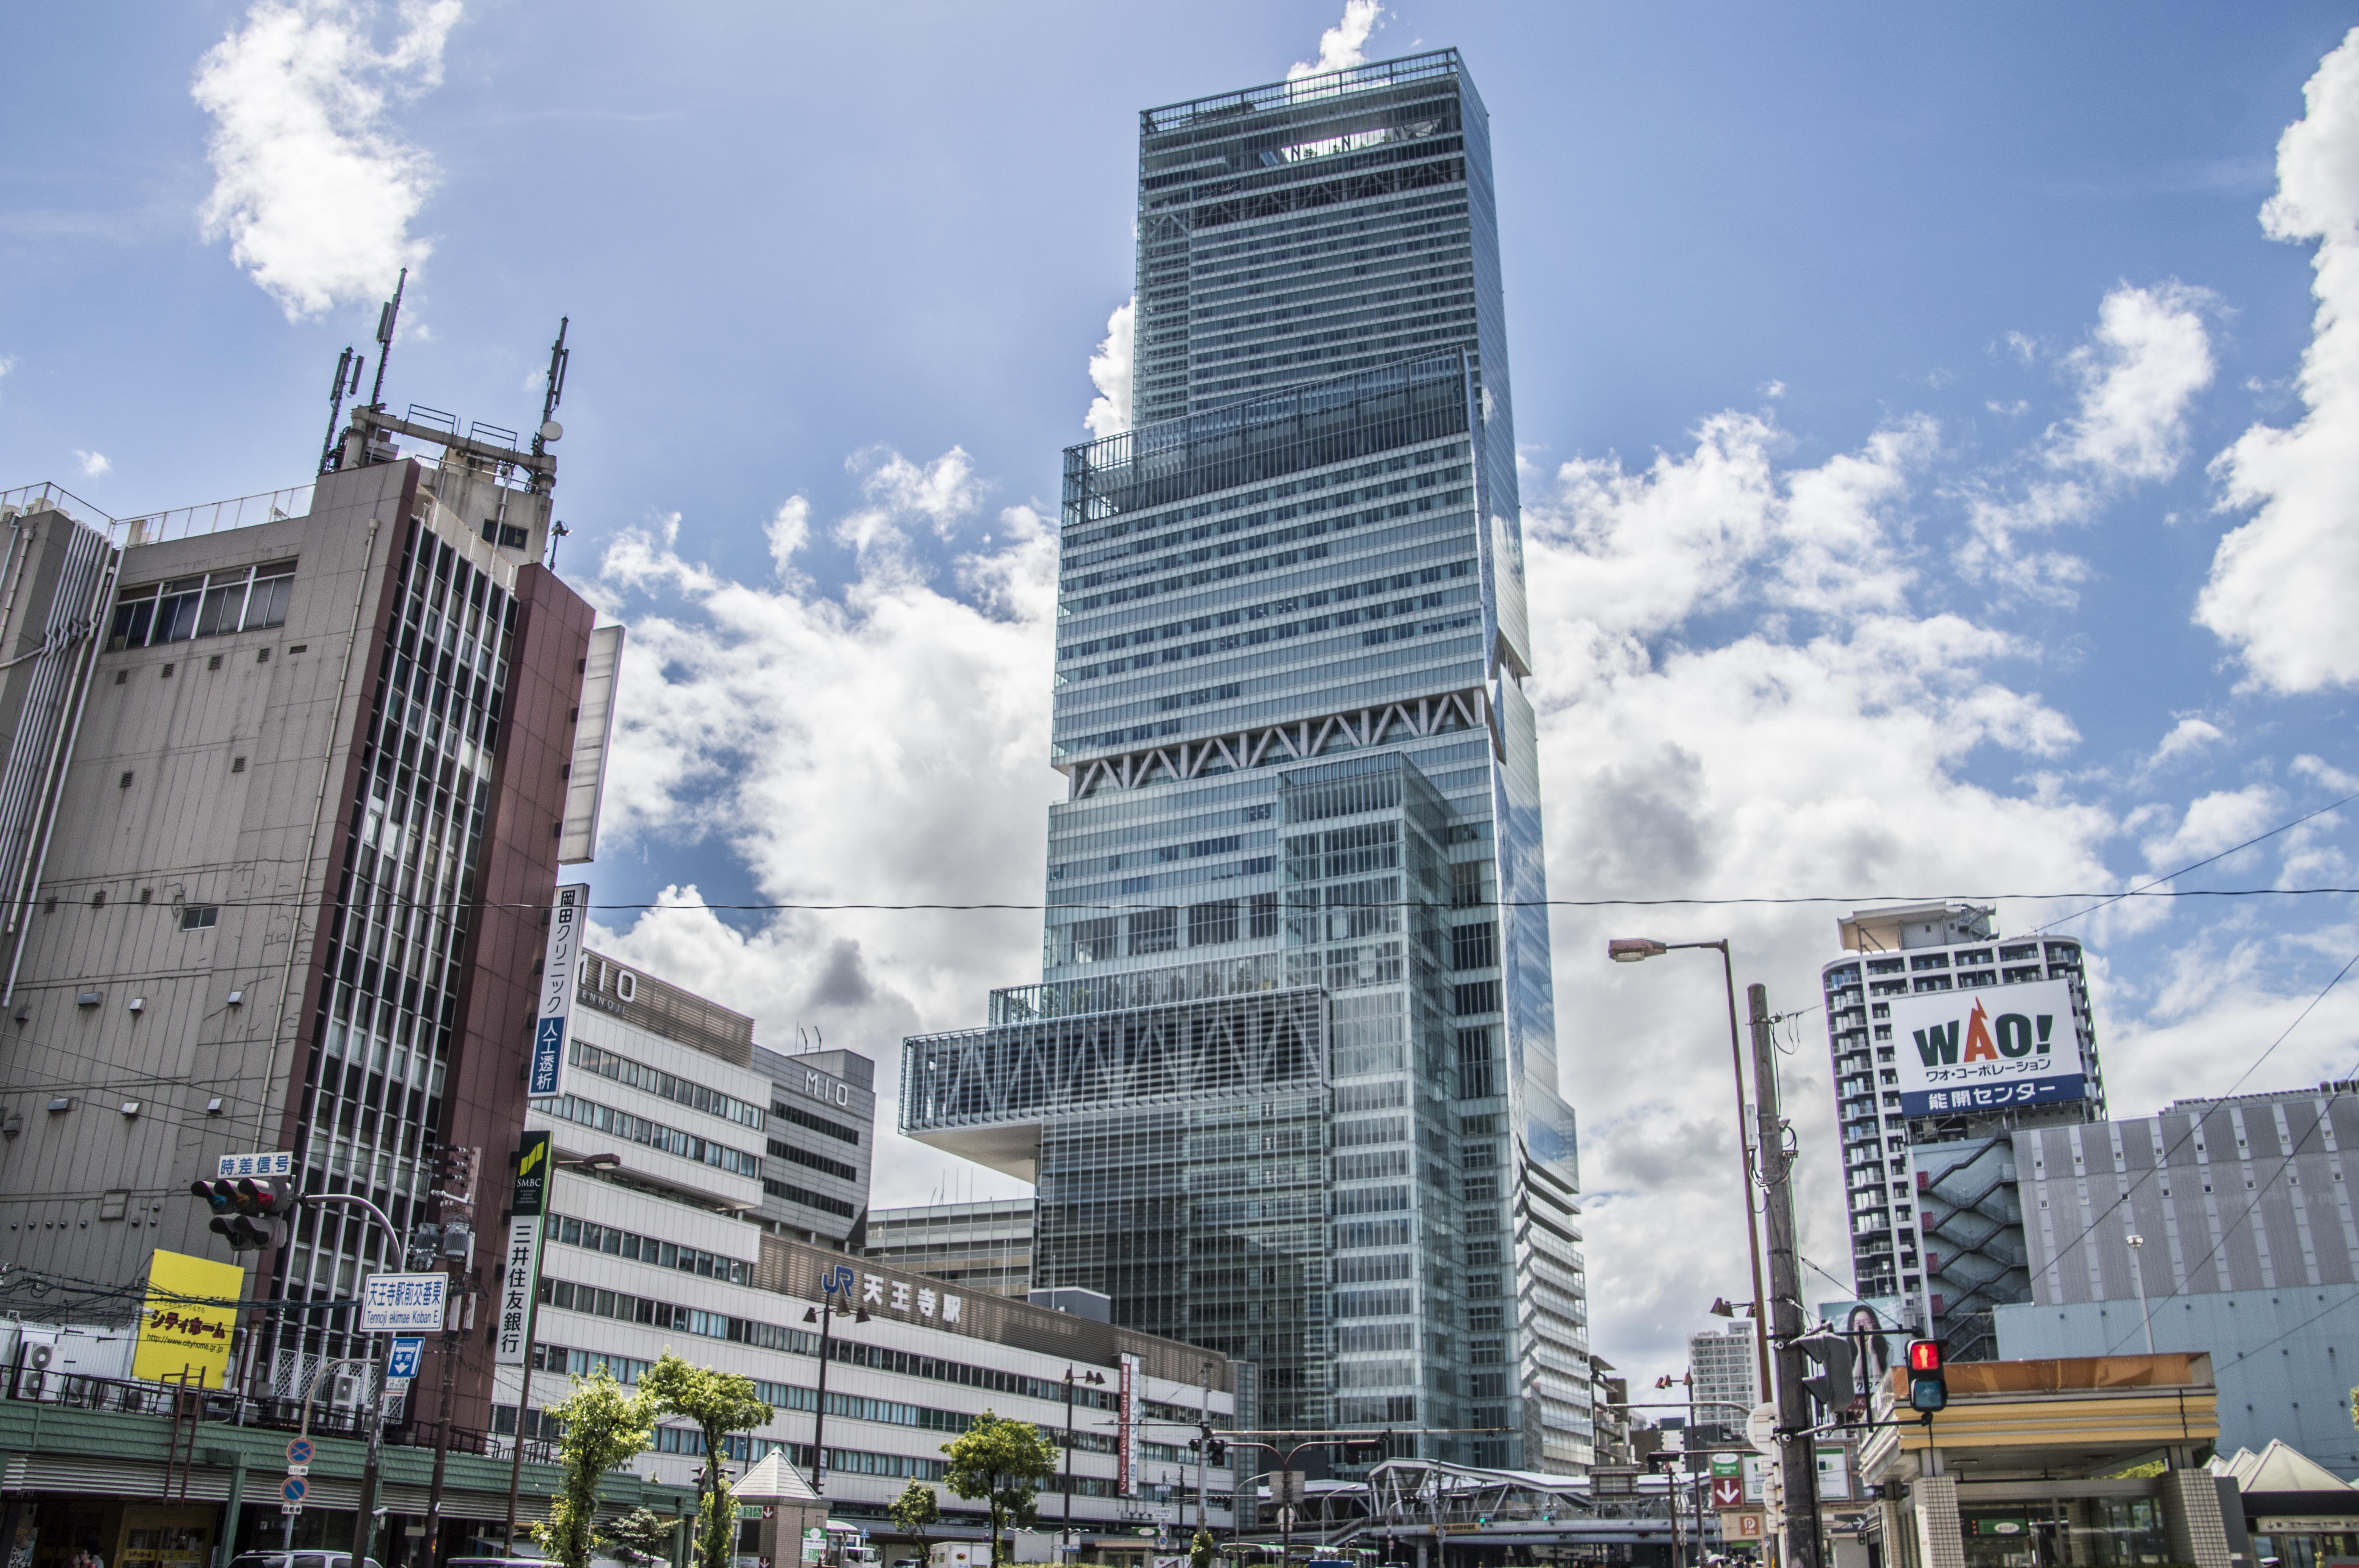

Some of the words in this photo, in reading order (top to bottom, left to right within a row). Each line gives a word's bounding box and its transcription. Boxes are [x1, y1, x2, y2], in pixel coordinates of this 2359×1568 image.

[547, 889, 576, 1014] 岡田クリニック
[578, 987, 625, 1014] ENNOJI
[1912, 996, 2053, 1067] WAO!
[536, 1020, 558, 1090] 人工透析
[1926, 1059, 2050, 1082] ワオ・コーポレーション
[805, 1070, 848, 1106] MIO
[1928, 1083, 2055, 1110] 能開センター
[220, 1155, 289, 1175] 時差信号
[516, 1178, 541, 1187] SMBC
[368, 1279, 442, 1307] 天王寺駅前交番東
[501, 1225, 531, 1353] 三井住友銀行
[863, 1273, 961, 1324] 天王寺駅
[151, 1309, 225, 1340] シティホーム
[367, 1310, 387, 1327] Tennoji
[389, 1311, 410, 1324] ekimae
[412, 1310, 431, 1324] Koban
[433, 1310, 440, 1323] E.
[147, 1333, 224, 1354] http://www.cityhome.gr.jp
